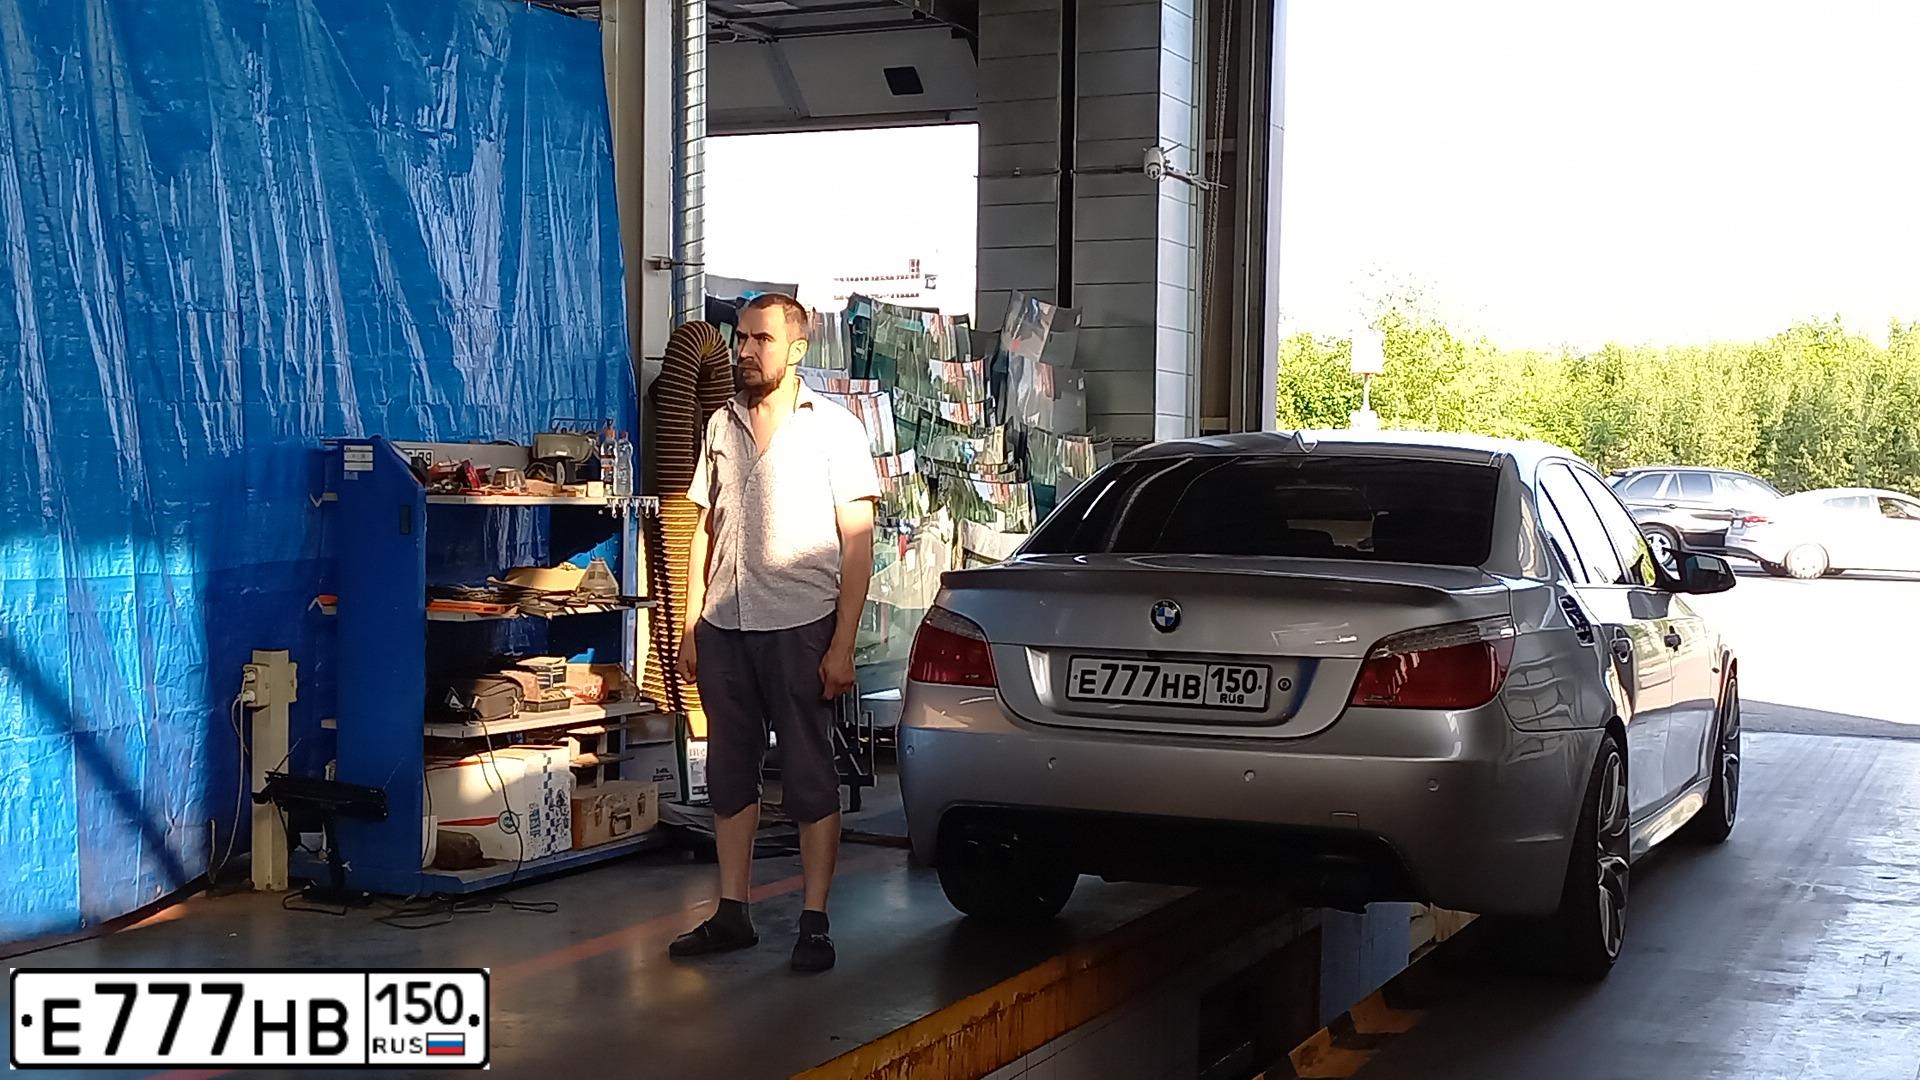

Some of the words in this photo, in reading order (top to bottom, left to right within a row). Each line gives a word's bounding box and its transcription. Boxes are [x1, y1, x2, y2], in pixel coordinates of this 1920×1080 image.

[1079, 663, 1201, 700] E777HB
[1211, 667, 1258, 694] 150
[1220, 693, 1245, 704] RUS
